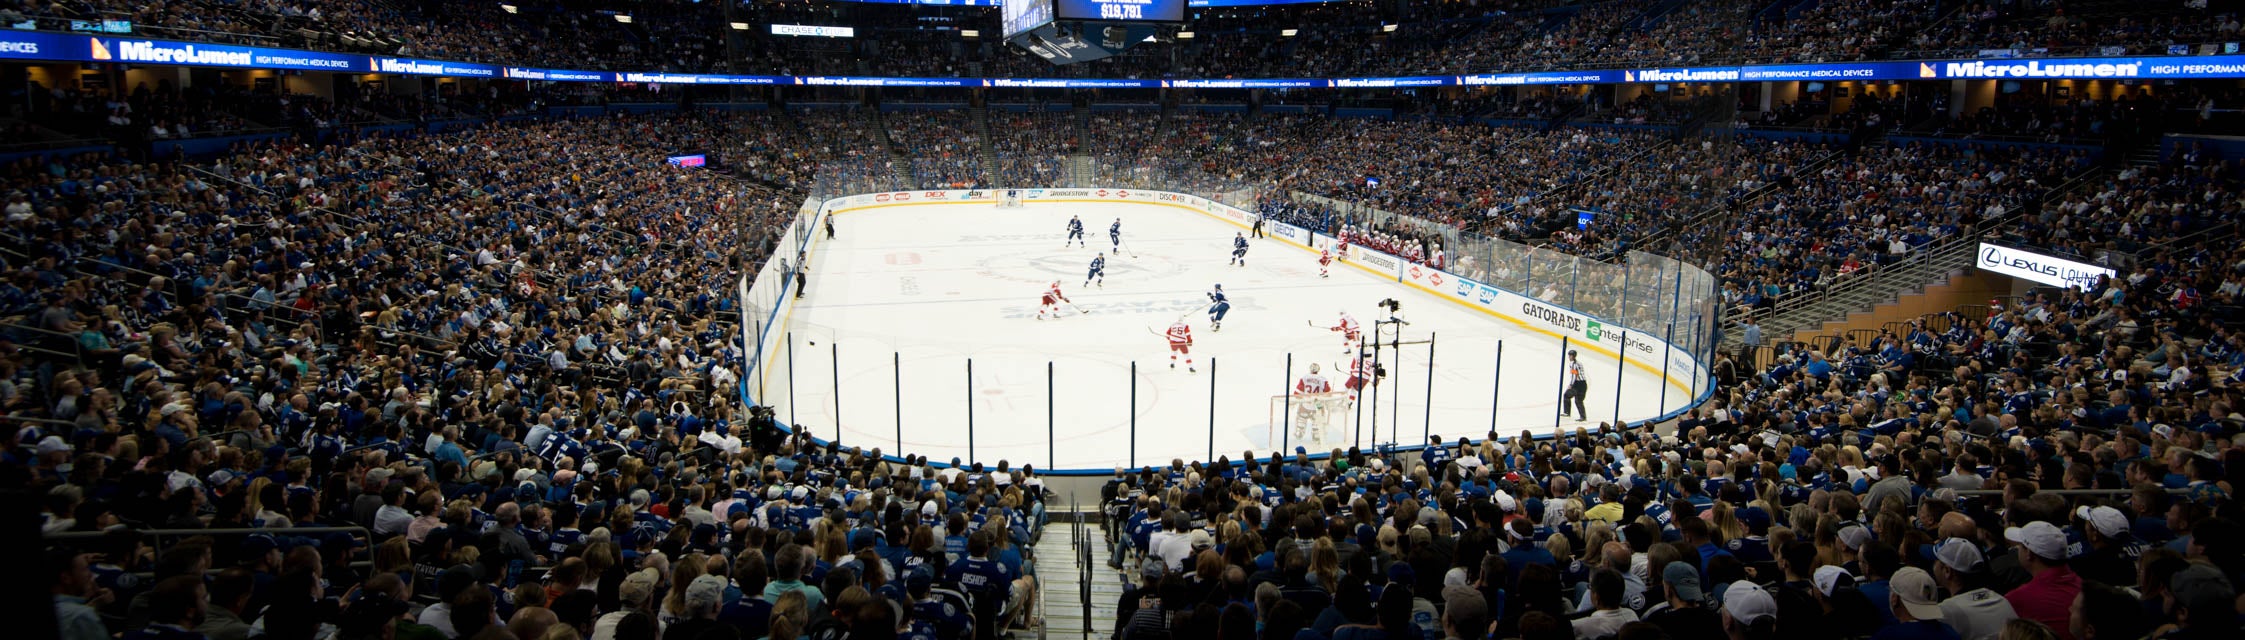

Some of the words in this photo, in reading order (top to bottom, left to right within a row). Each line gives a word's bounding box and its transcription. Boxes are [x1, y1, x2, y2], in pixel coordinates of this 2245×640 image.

[781, 26, 813, 35] CHASE
[0, 41, 38, 53] EVICES
[256, 56, 271, 64] HIGH
[272, 57, 309, 66] PERFORMANCE
[330, 60, 349, 68] DEVICES
[2150, 65, 2180, 75] HIGH
[969, 189, 983, 197] day
[1274, 223, 1295, 238] GEICO
[2004, 255, 2058, 277] LEXUS
[1458, 282, 1474, 295] SAP
[1480, 289, 1496, 302] SAP
[1522, 302, 1581, 332] GATORADE
[1590, 324, 1653, 354] enterprise
[962, 572, 987, 586] BISHOP
